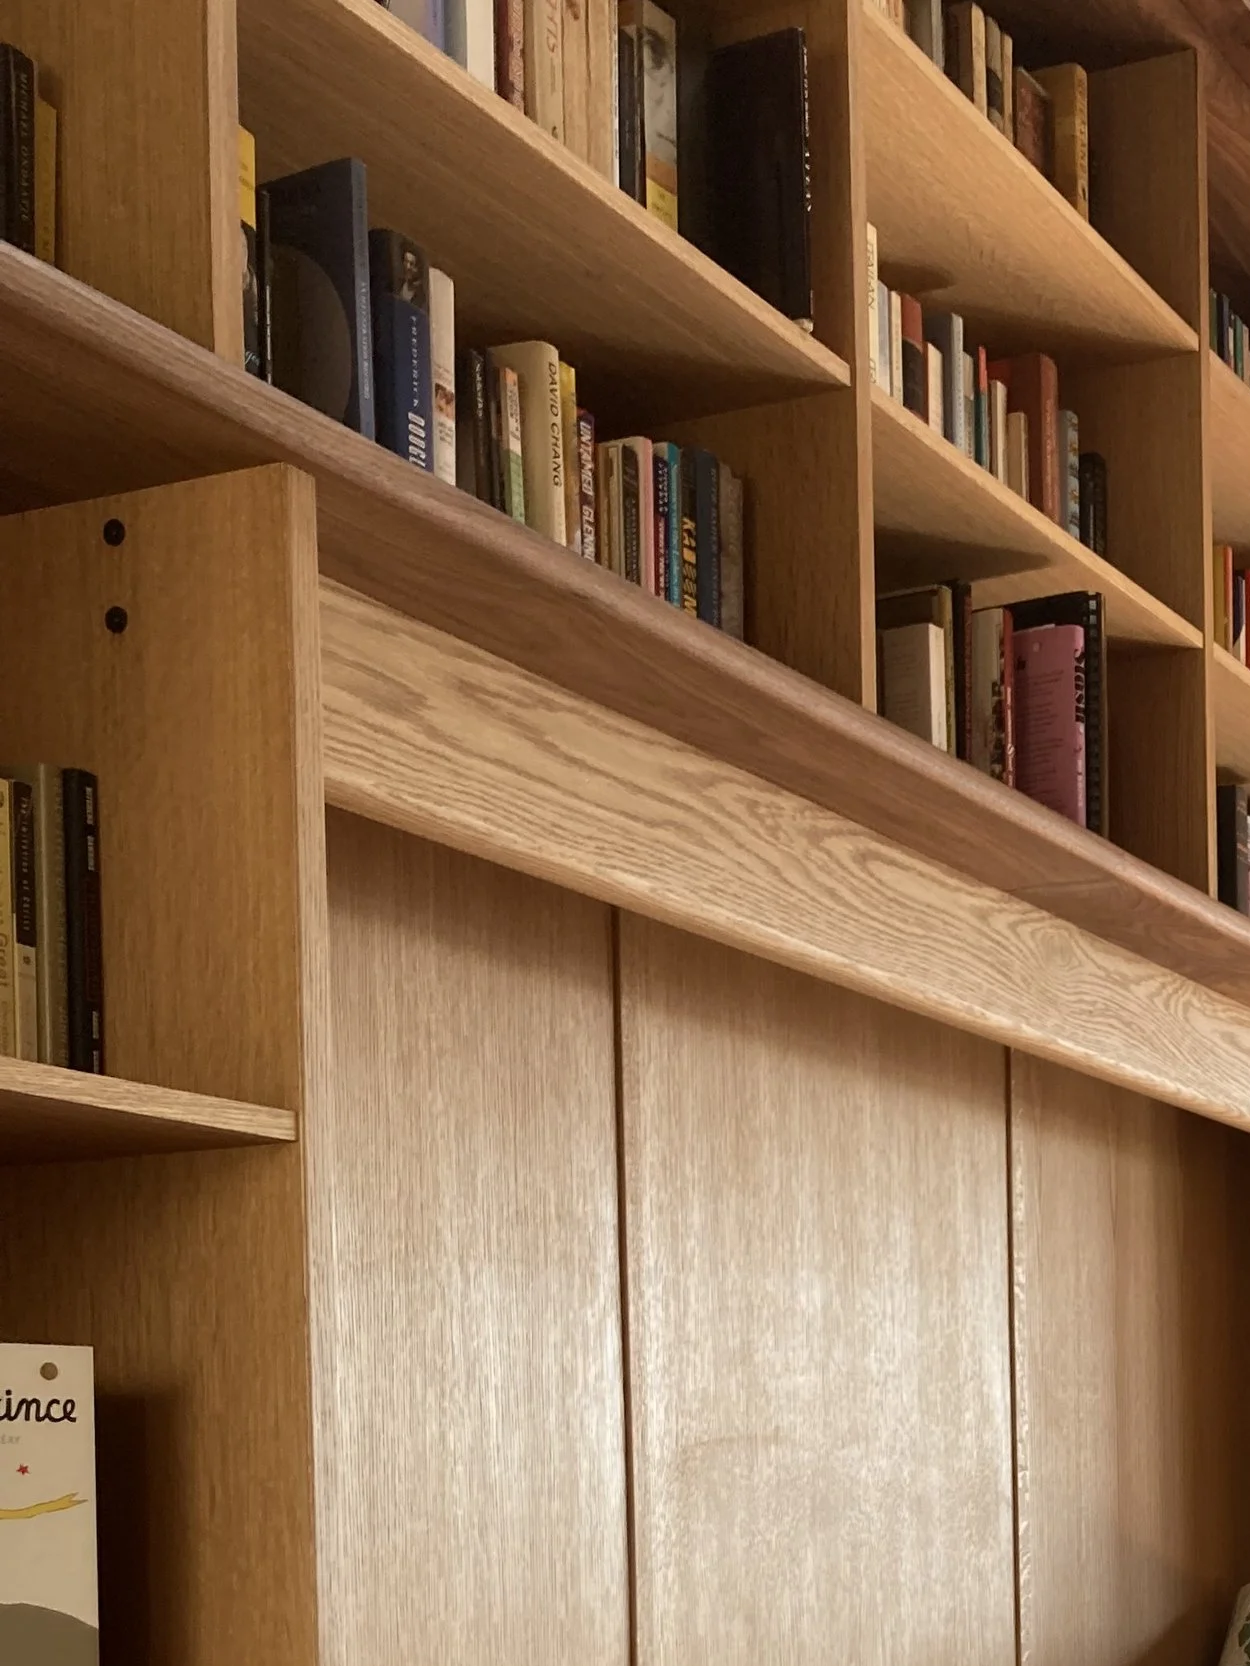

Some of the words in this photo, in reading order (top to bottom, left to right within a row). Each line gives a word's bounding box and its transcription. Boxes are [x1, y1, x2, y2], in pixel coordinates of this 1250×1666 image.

[548, 362, 560, 417] DAVID
[551, 422, 562, 489] CHANG
[580, 421, 594, 495] UNTAMED
[0, 1388, 77, 1423] ince
